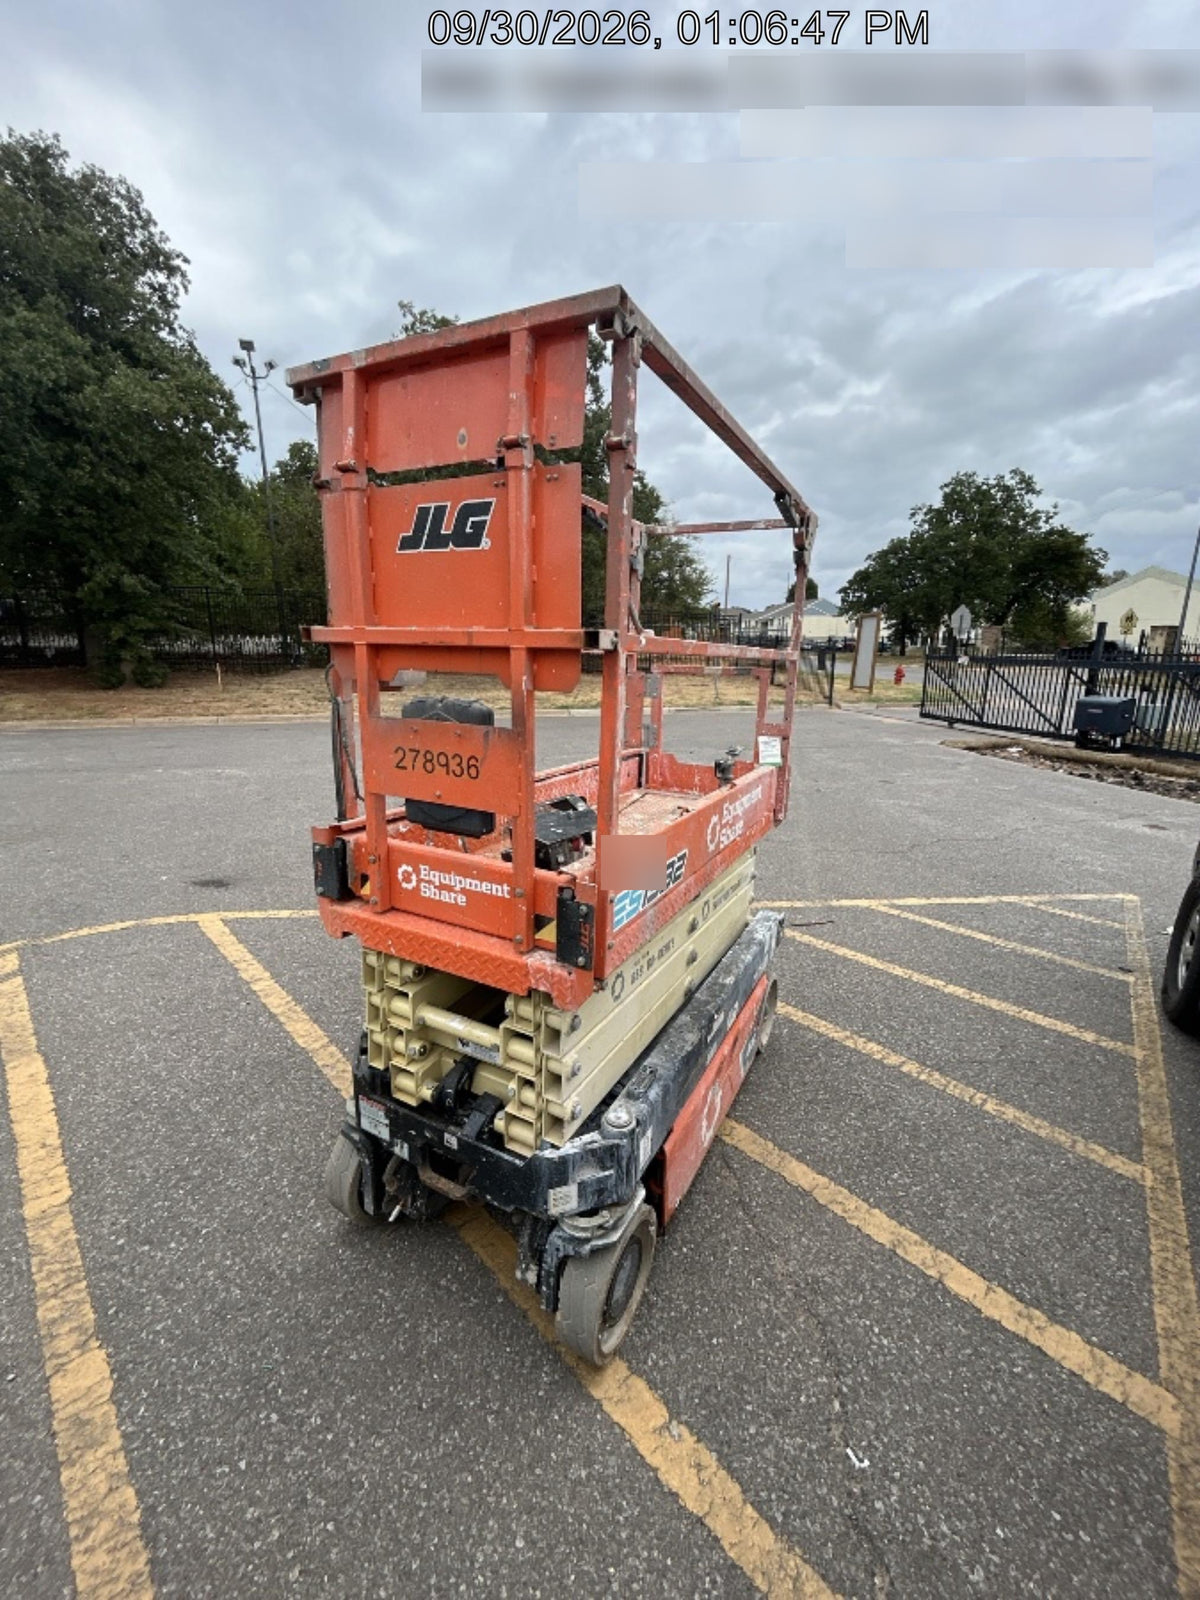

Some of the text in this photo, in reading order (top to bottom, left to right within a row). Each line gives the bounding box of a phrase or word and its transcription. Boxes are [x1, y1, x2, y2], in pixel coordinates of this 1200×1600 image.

[396, 498, 496, 553] JLG
[394, 746, 479, 779] 278936
[419, 864, 511, 898] Equipment
[420, 882, 467, 906] Share
